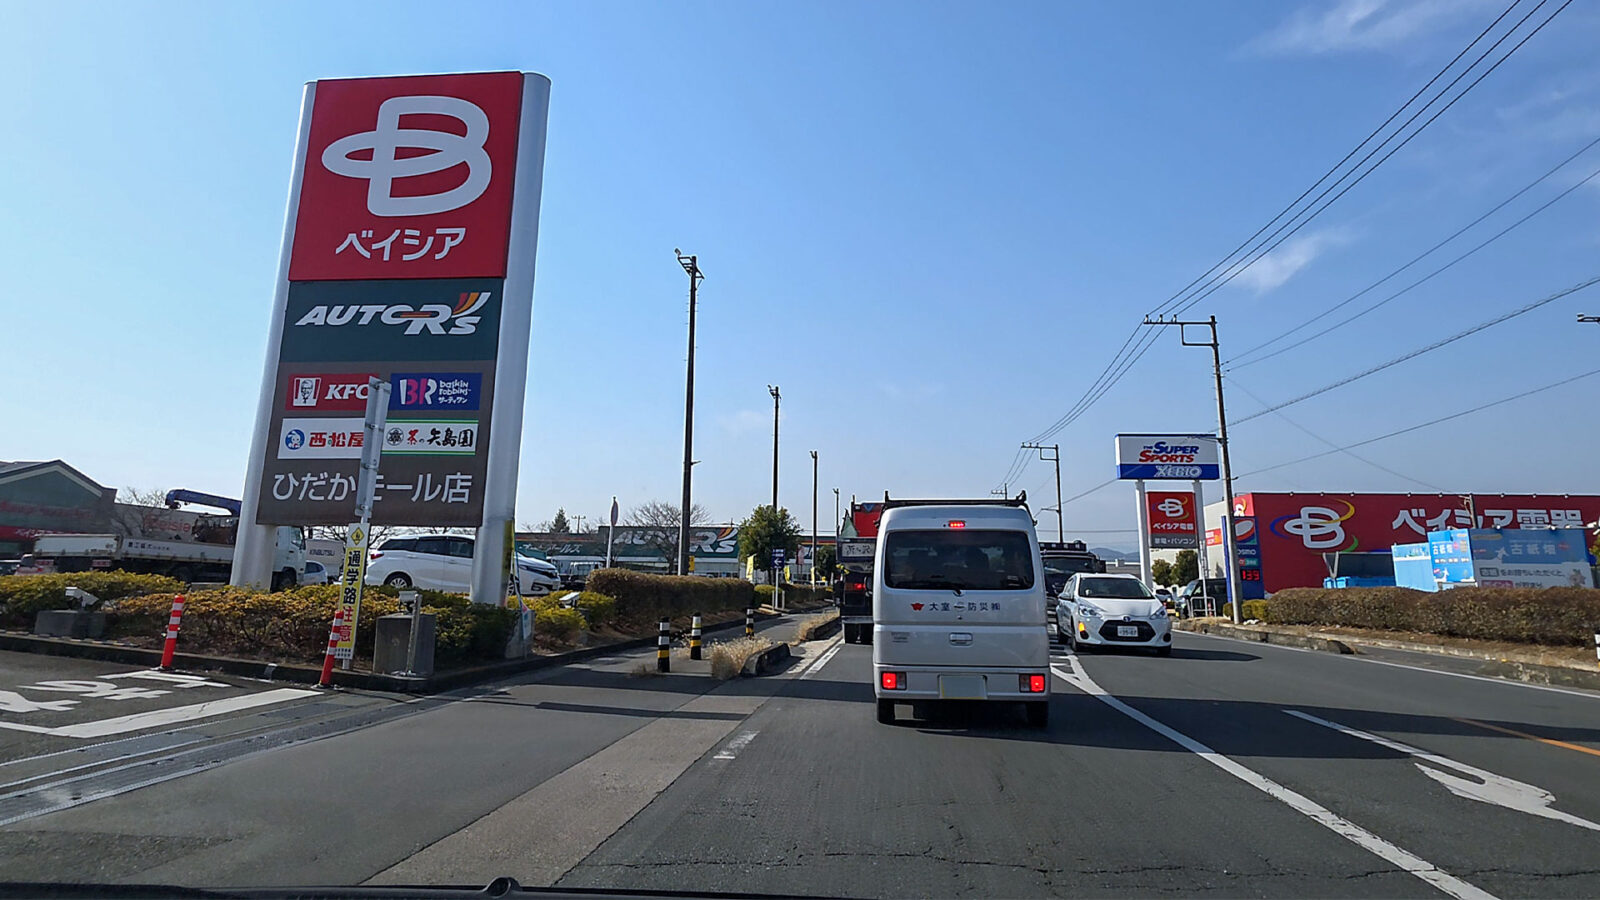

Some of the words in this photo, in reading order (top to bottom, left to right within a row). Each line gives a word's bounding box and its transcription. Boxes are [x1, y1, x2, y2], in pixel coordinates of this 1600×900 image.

[335, 227, 466, 262] ベイシア
[324, 384, 369, 400] KFC
[438, 396, 468, 404] サーティワン
[309, 431, 364, 448] 西松屋
[1153, 441, 1199, 454] SUPER
[1138, 450, 1195, 463] SPORTS
[1154, 465, 1203, 478] XEBIO
